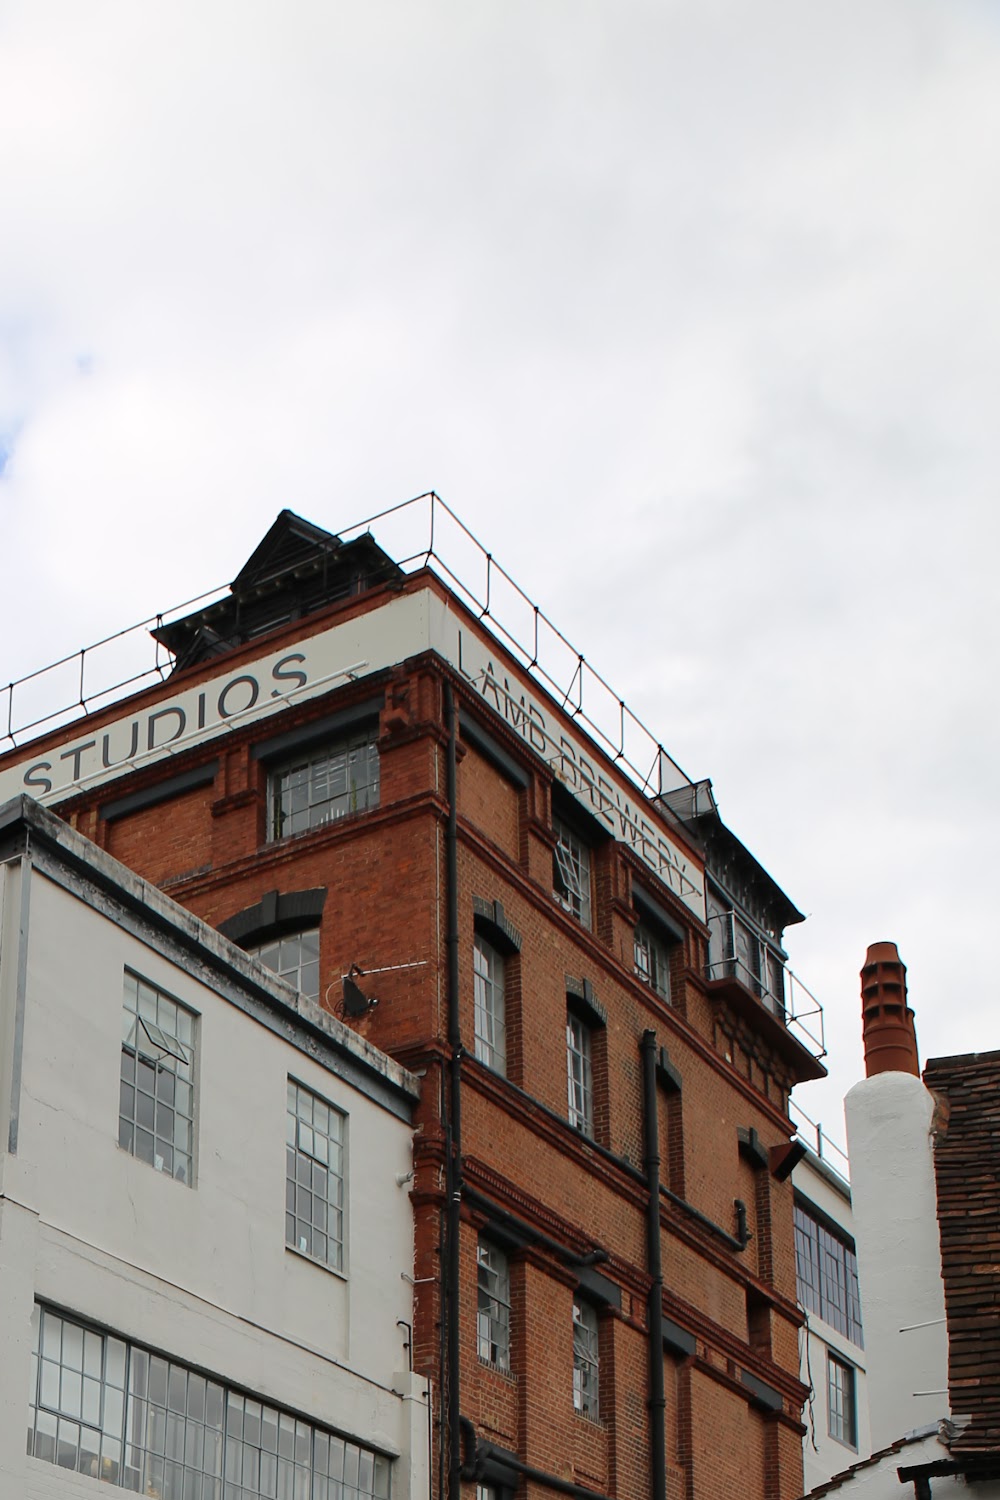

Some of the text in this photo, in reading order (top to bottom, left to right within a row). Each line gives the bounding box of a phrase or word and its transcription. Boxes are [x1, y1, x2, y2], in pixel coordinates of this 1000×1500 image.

[23, 653, 308, 796] STUDIOS
[458, 630, 687, 895] LAMB BREWERY
